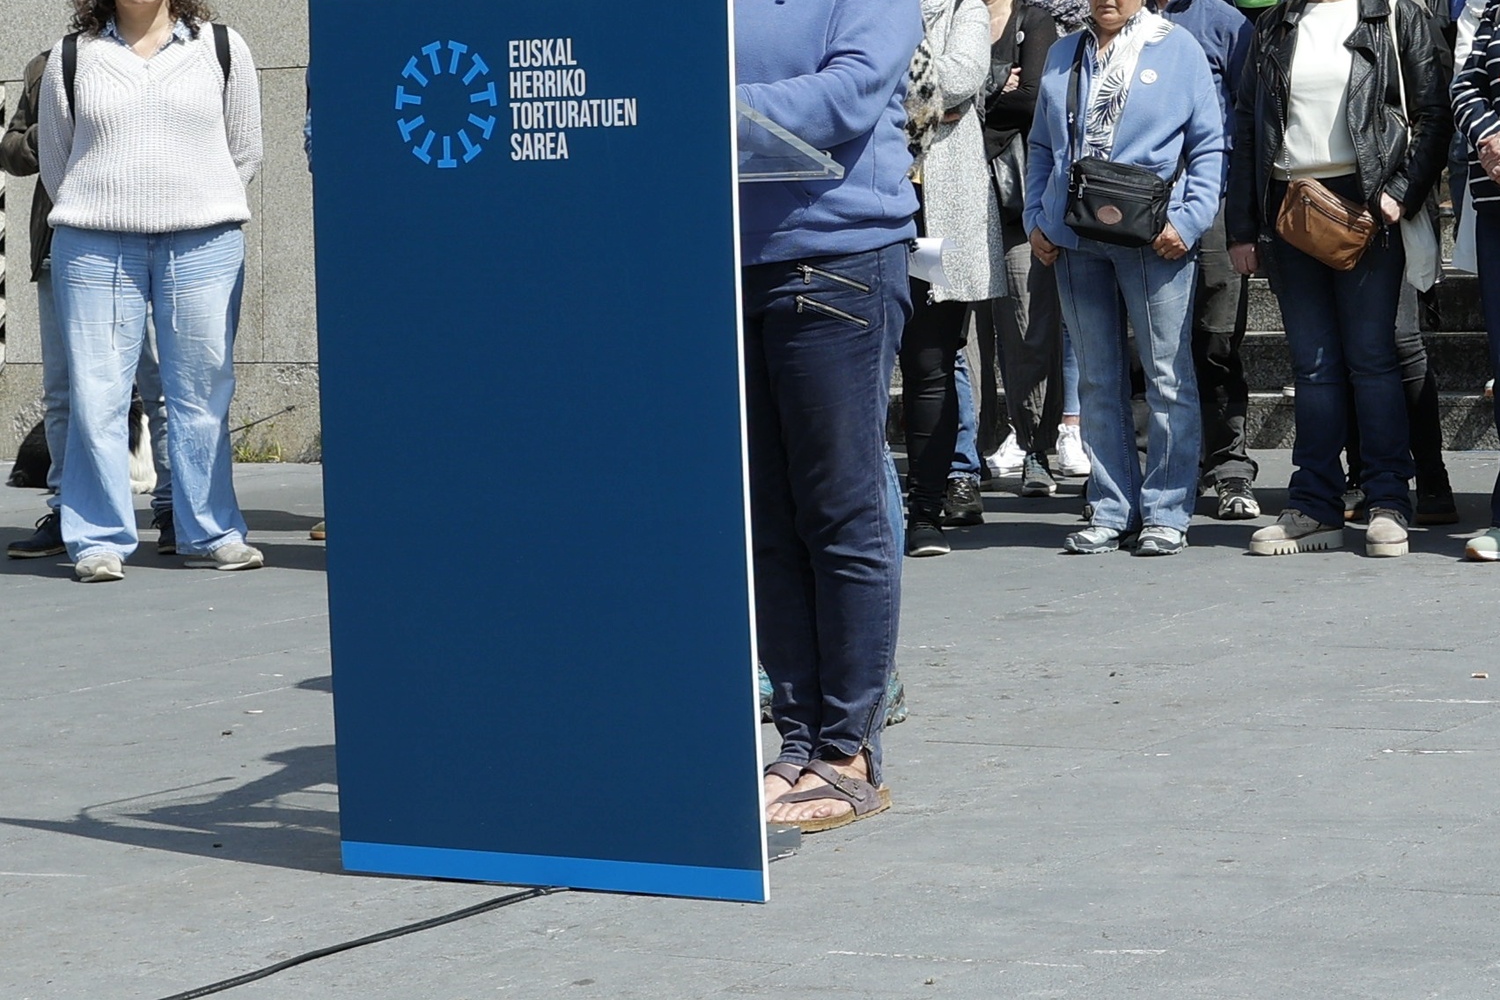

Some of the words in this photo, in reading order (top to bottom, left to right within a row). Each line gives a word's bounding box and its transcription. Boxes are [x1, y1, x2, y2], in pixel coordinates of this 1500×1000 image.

[508, 38, 577, 68] EUSKAL
[509, 68, 586, 99] HERRIKO
[509, 98, 637, 130] TORTURATUEN
[510, 131, 569, 161] SAREA
